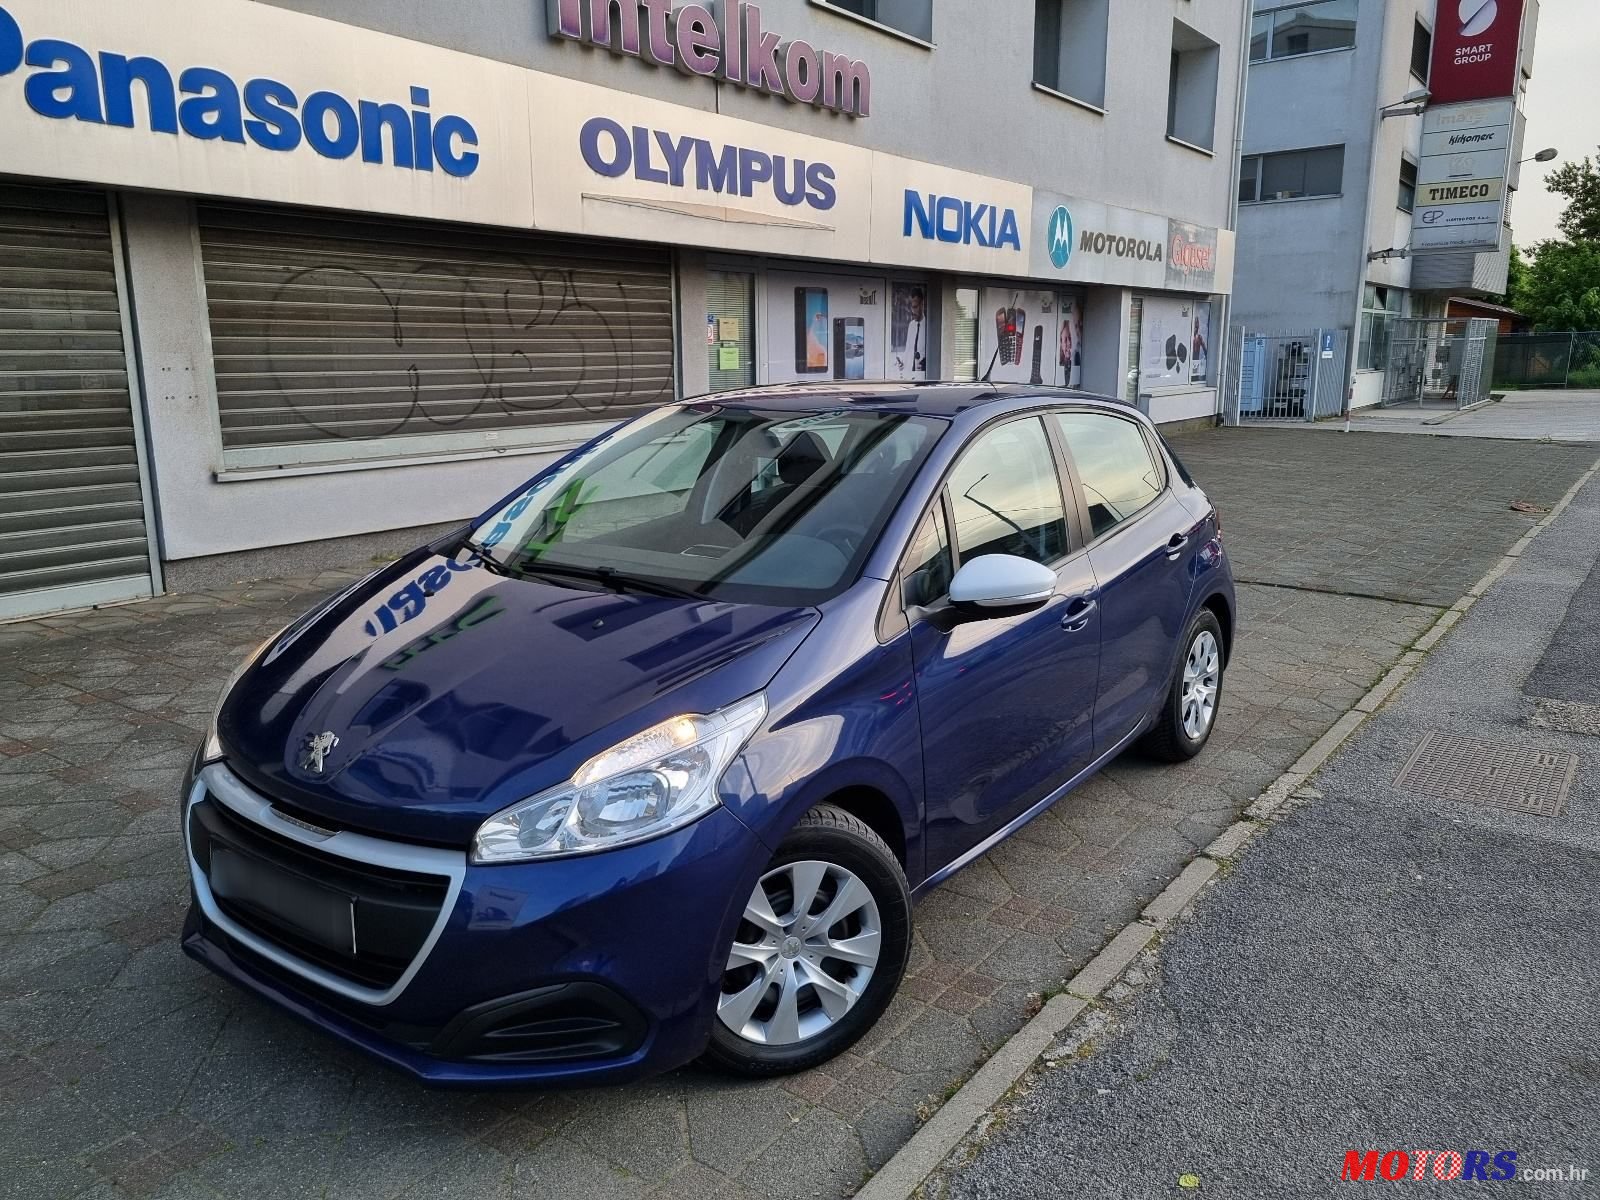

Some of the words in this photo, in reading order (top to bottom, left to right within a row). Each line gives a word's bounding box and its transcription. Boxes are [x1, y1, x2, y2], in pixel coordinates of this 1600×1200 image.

[1453, 53, 1492, 65] GROUP
[1455, 43, 1493, 56] SMART
[579, 117, 836, 210] OLYMPUS
[1429, 184, 1489, 201] TIMECO
[903, 188, 1021, 251] NOKIA
[1080, 230, 1162, 262] MOTOROLA
